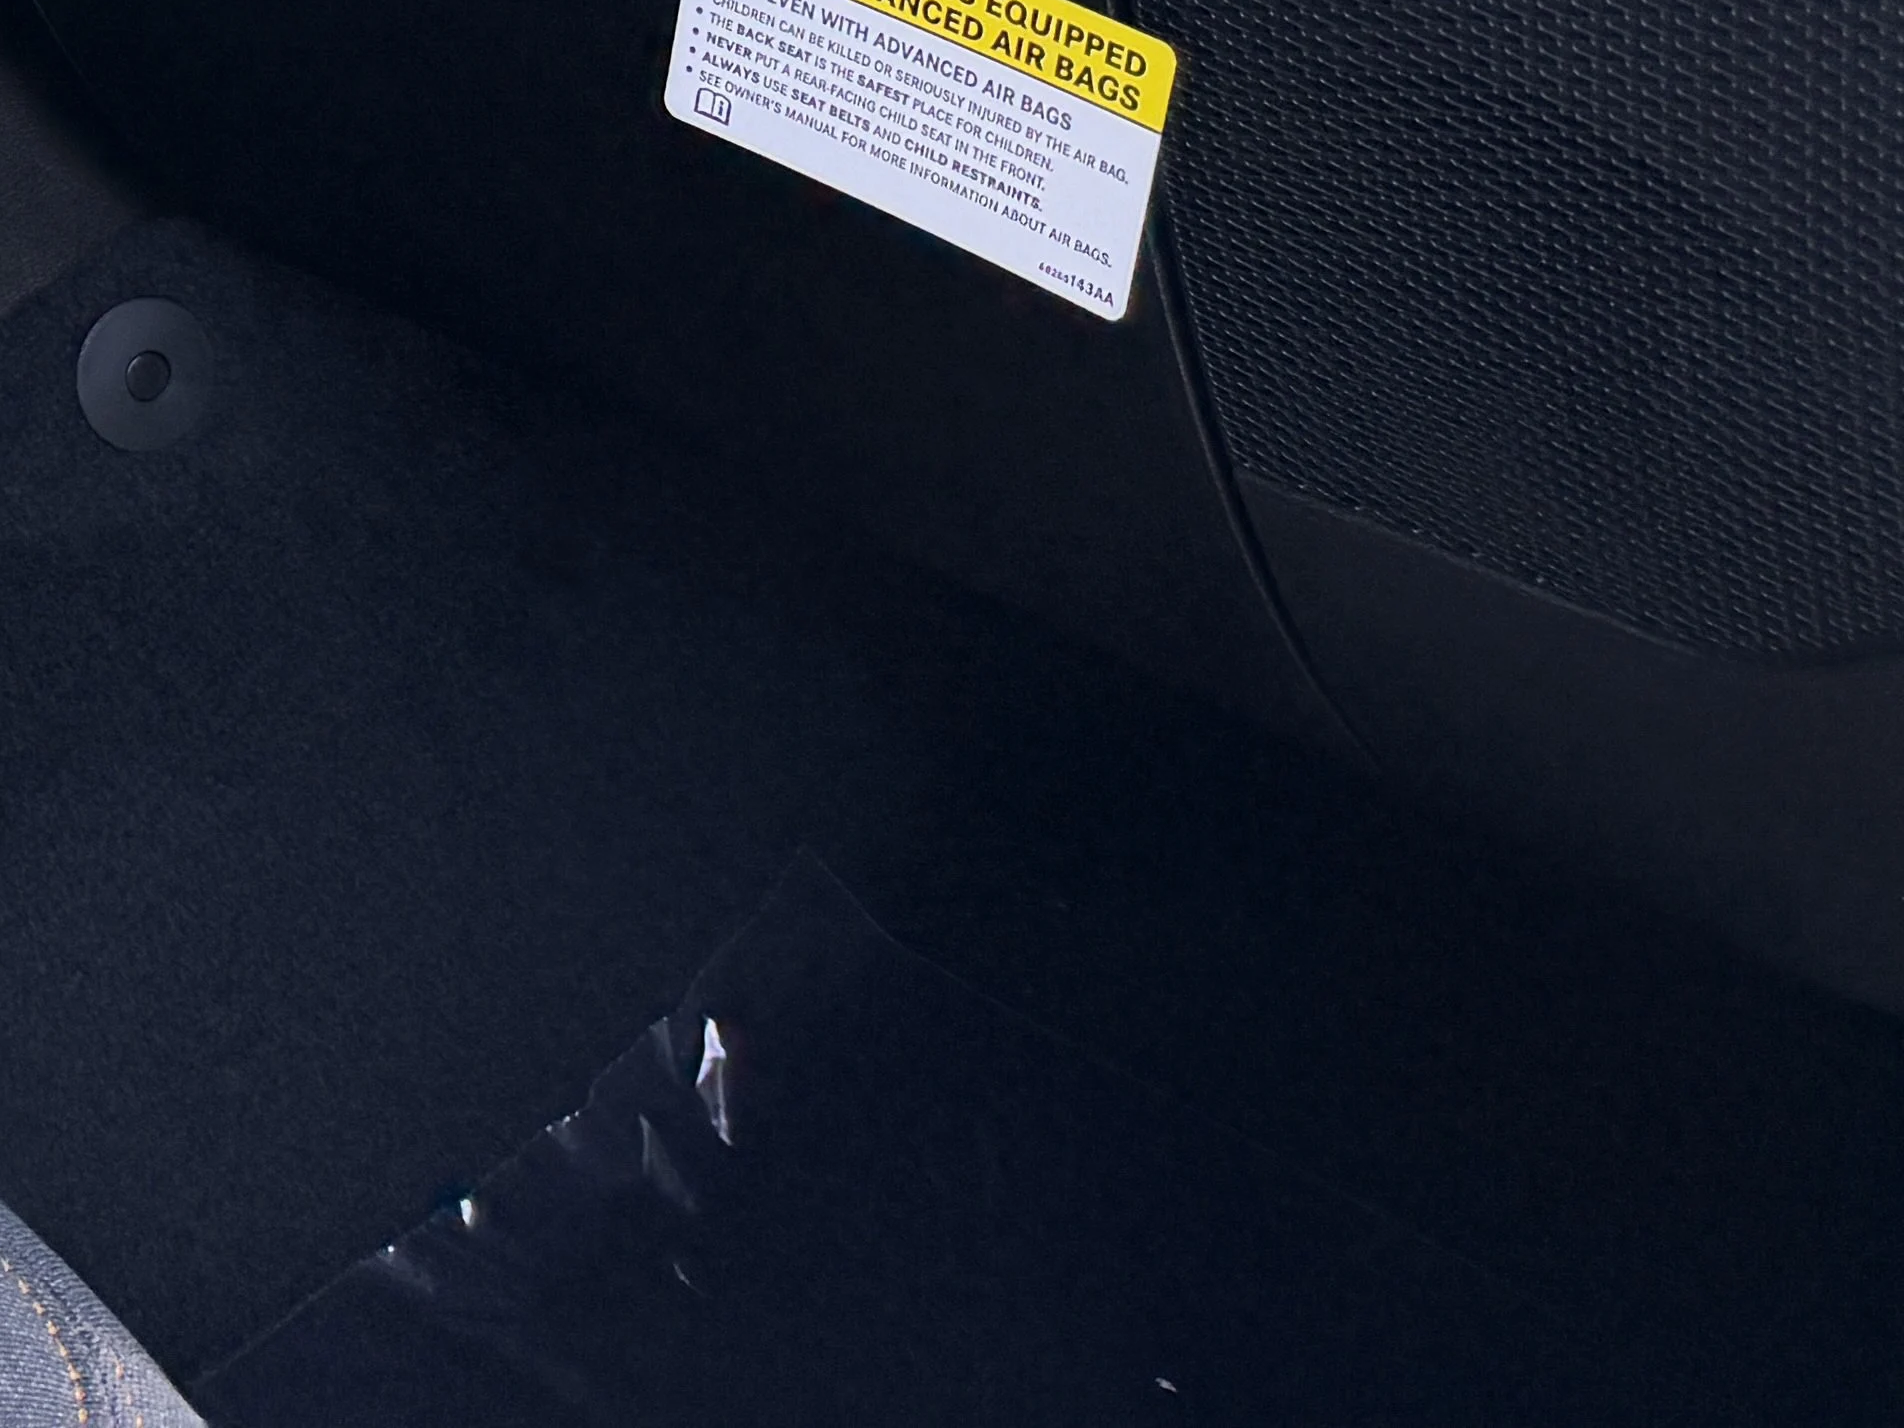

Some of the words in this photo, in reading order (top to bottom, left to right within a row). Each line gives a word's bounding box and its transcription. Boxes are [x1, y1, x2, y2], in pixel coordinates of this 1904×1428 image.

[702, 51, 760, 84] ALWAYS
[763, 75, 788, 96] USE
[791, 88, 826, 112] SEAT
[829, 104, 870, 133] BELTS
[873, 125, 901, 145] AND
[904, 139, 948, 166] CHILD
[952, 159, 1043, 212] RESTRAINTS.
[706, 31, 752, 60] NEVER
[755, 52, 780, 71] PUT
[781, 63, 791, 77] A
[794, 68, 876, 113] REAR-FACING
[879, 104, 917, 131] CHILD
[921, 123, 952, 146] SEAT
[955, 139, 970, 155] IN
[973, 146, 998, 168] THE
[1000, 159, 1045, 191] FRONT.
[709, 11, 733, 32] THE
[736, 23, 774, 46] BACK
[778, 40, 812, 63] SEAT
[814, 55, 827, 70] IS
[830, 62, 855, 82] THE
[857, 74, 910, 105] SAFEST
[913, 97, 953, 126] PLACE
[956, 117, 982, 139] FOR
[984, 130, 1054, 172] CHILDREN.
[779, 20, 806, 40] CAN
[809, 32, 824, 48] BE
[828, 40, 871, 67] KILLED
[874, 59, 892, 78] OR
[895, 69, 966, 108] SERIOUSLY
[968, 100, 1022, 134] INJURED
[1026, 126, 1043, 142] BY
[1046, 134, 1071, 157] THE
[1073, 149, 1096, 169] AIR
[1099, 161, 1129, 185] BAG.
[821, 8, 869, 42] WITH
[873, 32, 978, 87] ADVANCED
[982, 79, 1015, 106] AIR
[1020, 95, 1072, 131] BAGS
[990, 31, 1047, 71] AIR
[1054, 55, 1141, 111] BAGS
[699, 70, 721, 89] SEE
[724, 80, 782, 114] OWNER'S
[785, 106, 838, 140] MANUAL
[841, 131, 867, 153] FOR
[870, 143, 907, 170] MORE
[909, 161, 998, 213] INFORMATION
[1001, 205, 1047, 235] ABOUT
[1048, 228, 1072, 248] AIR
[1074, 240, 1112, 268] BAGS.
